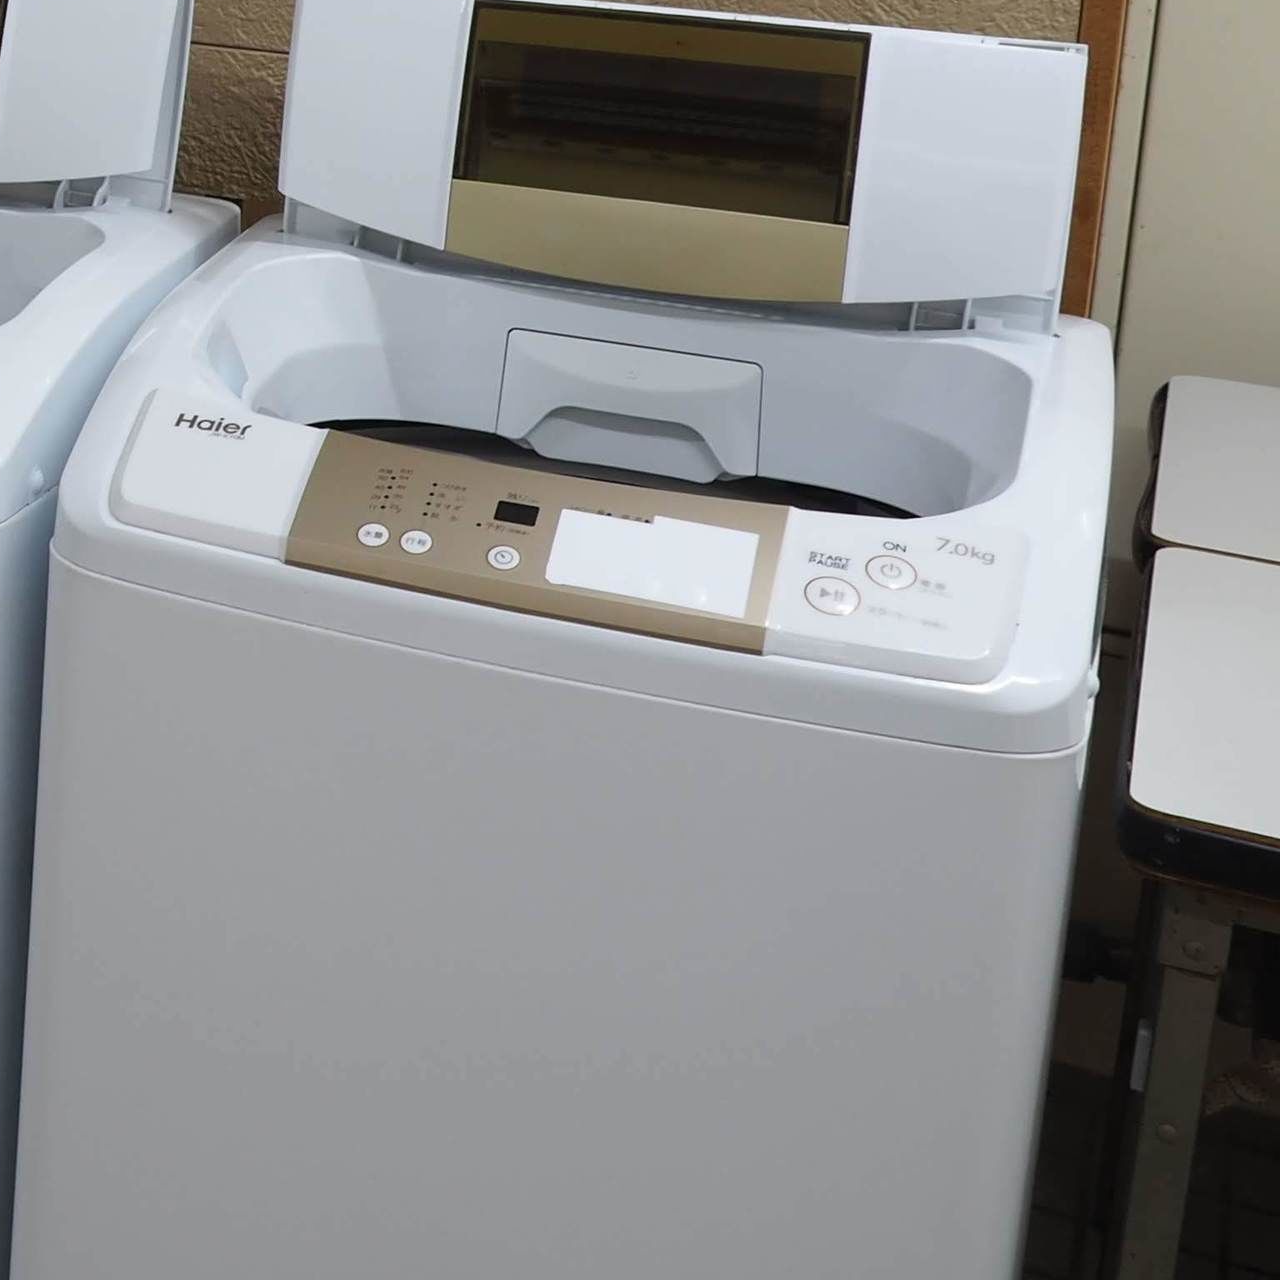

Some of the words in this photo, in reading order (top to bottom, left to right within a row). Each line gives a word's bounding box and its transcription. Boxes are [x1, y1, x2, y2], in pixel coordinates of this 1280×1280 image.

[174, 412, 252, 436] Haier
[882, 540, 908, 553] ON
[936, 536, 996, 566] 7.0kg
[808, 559, 849, 570] PAUSE
[810, 551, 852, 565] START
